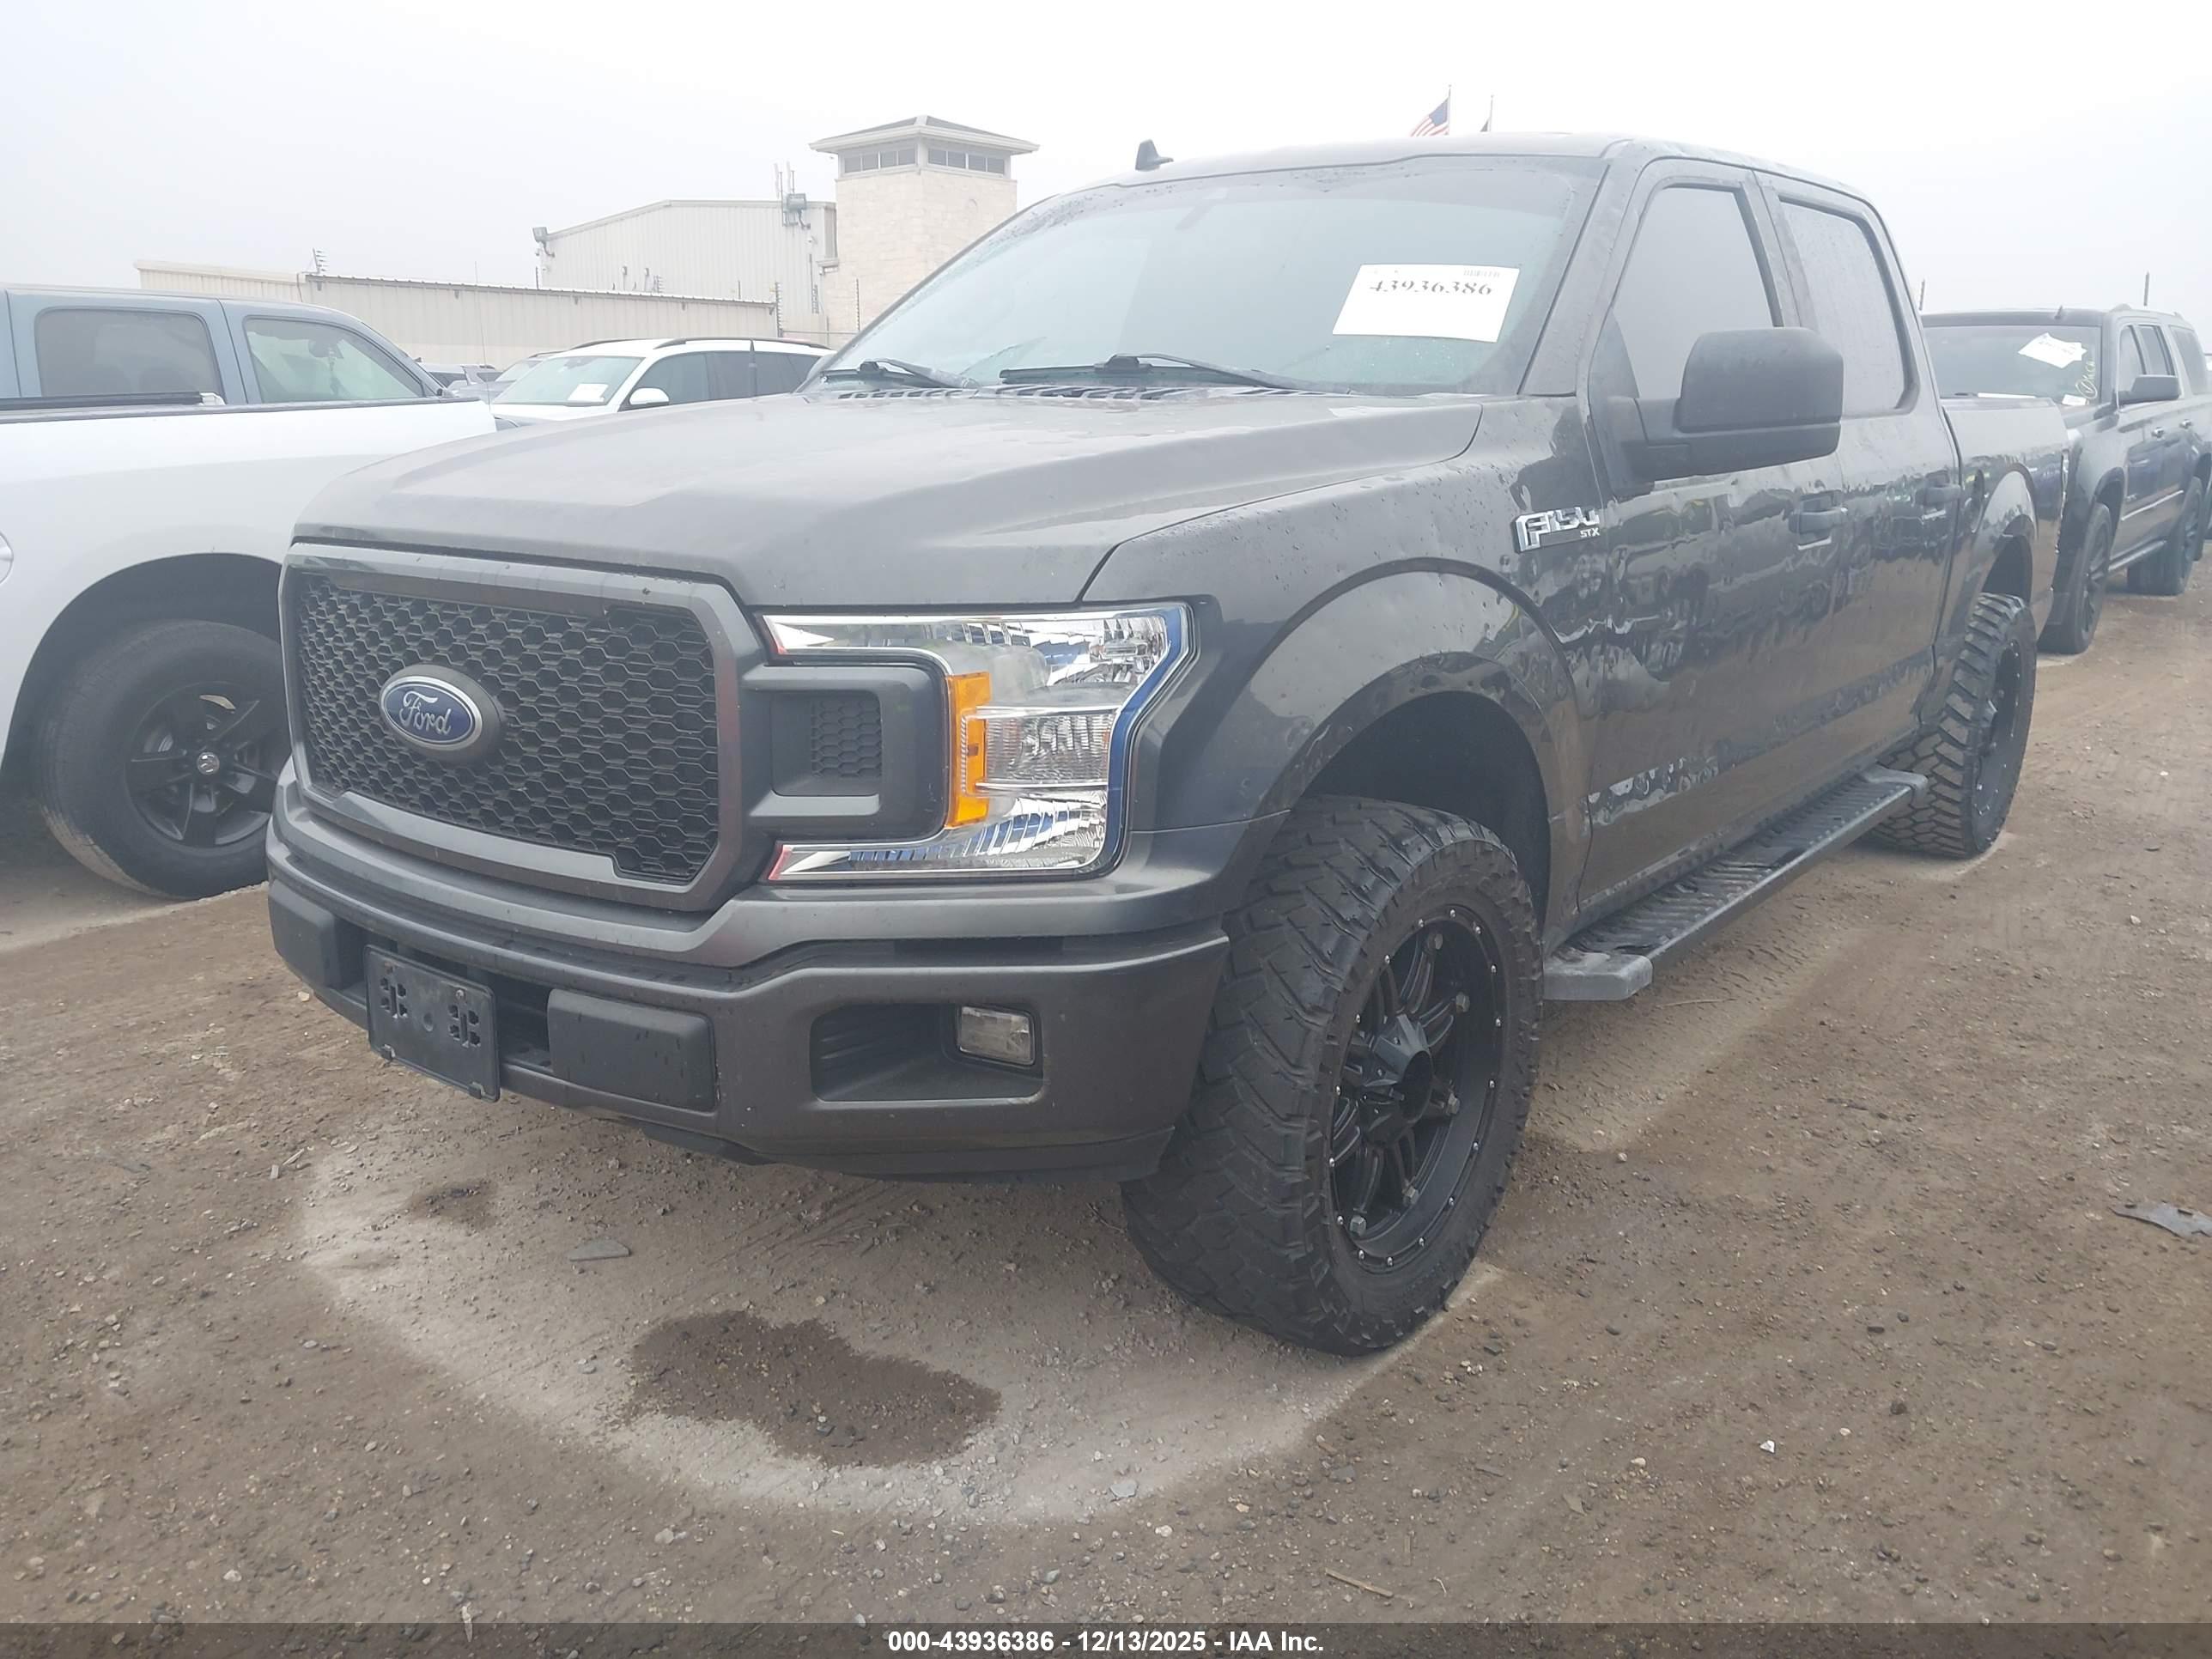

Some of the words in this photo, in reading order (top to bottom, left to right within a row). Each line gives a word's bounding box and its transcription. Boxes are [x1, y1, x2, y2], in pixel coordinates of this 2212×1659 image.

[1369, 279, 1492, 295] 43936386
[1579, 527, 1601, 538] STX
[398, 690, 453, 736] Ford
